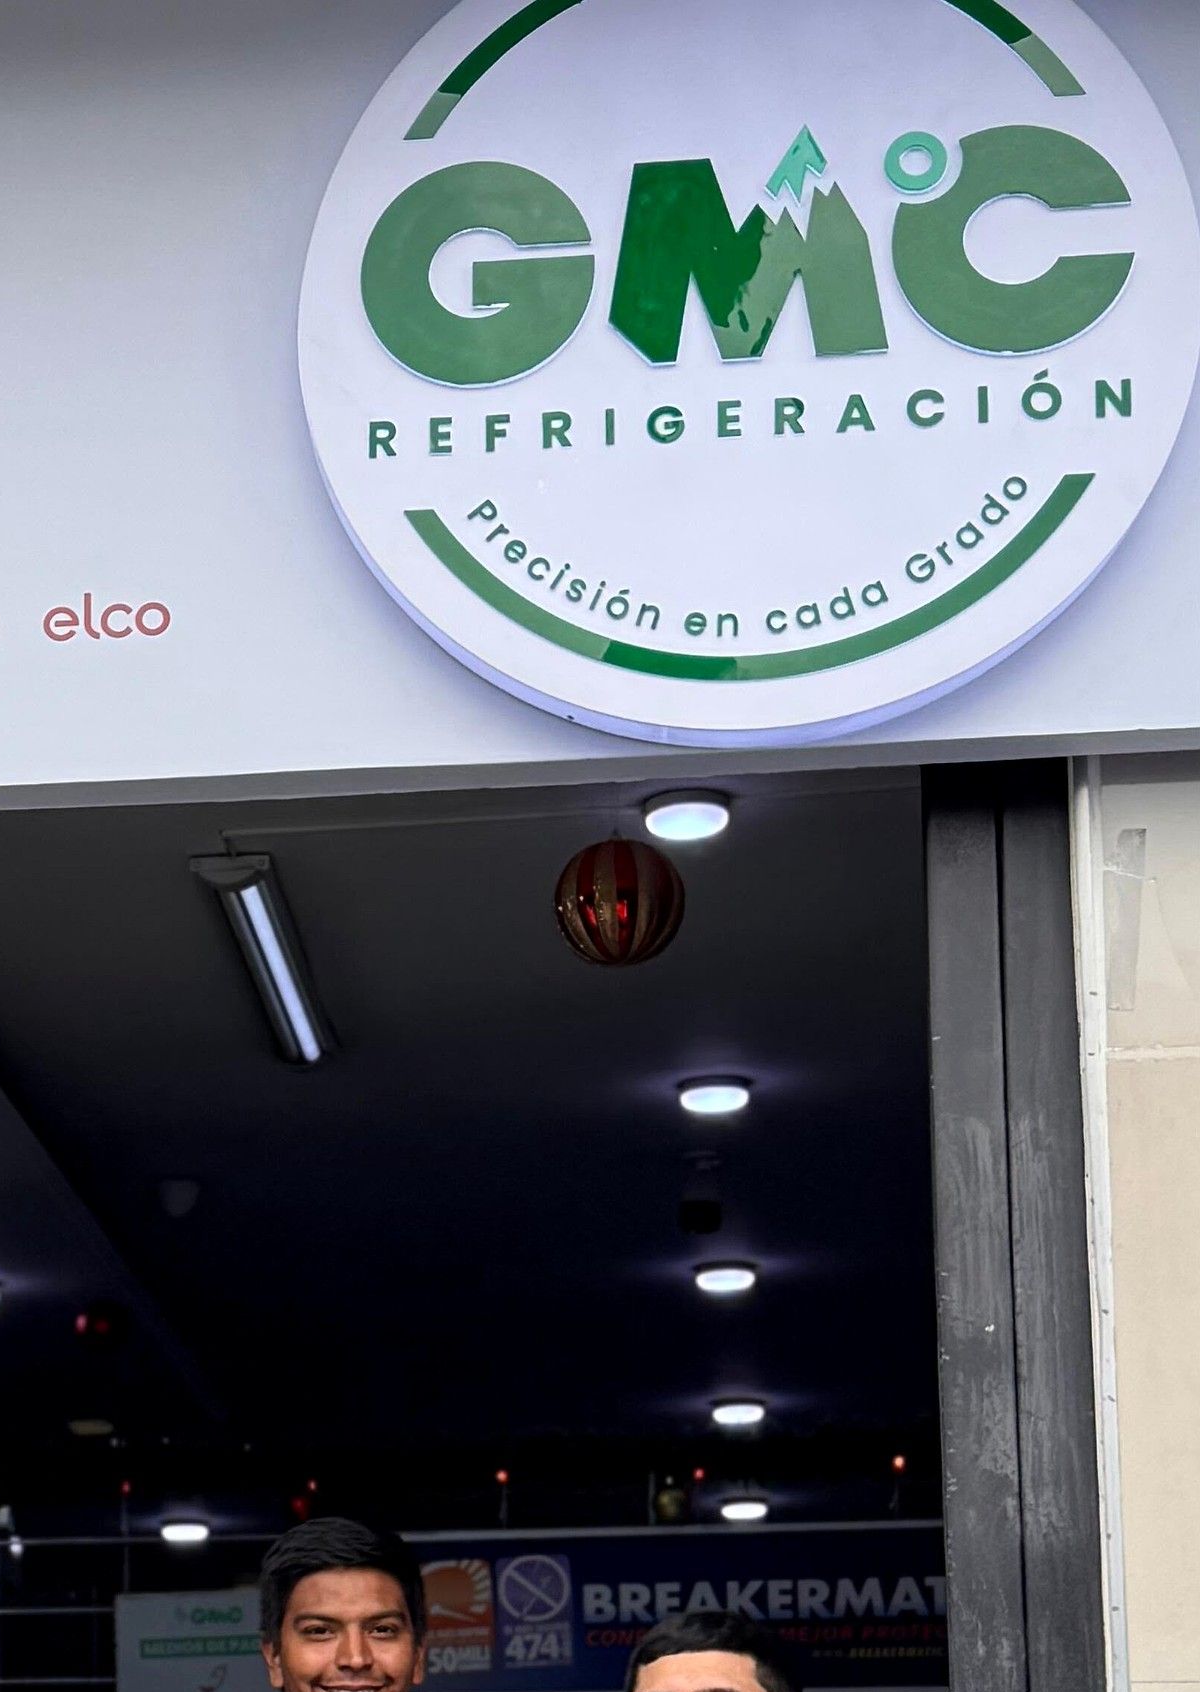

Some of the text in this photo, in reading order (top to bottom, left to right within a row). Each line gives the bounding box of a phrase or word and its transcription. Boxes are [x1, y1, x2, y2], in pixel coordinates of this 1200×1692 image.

[368, 371, 1135, 459] REFRIGERACIÓN
[466, 475, 1029, 638] Precisión en cada Grado
[42, 592, 172, 643] elco
